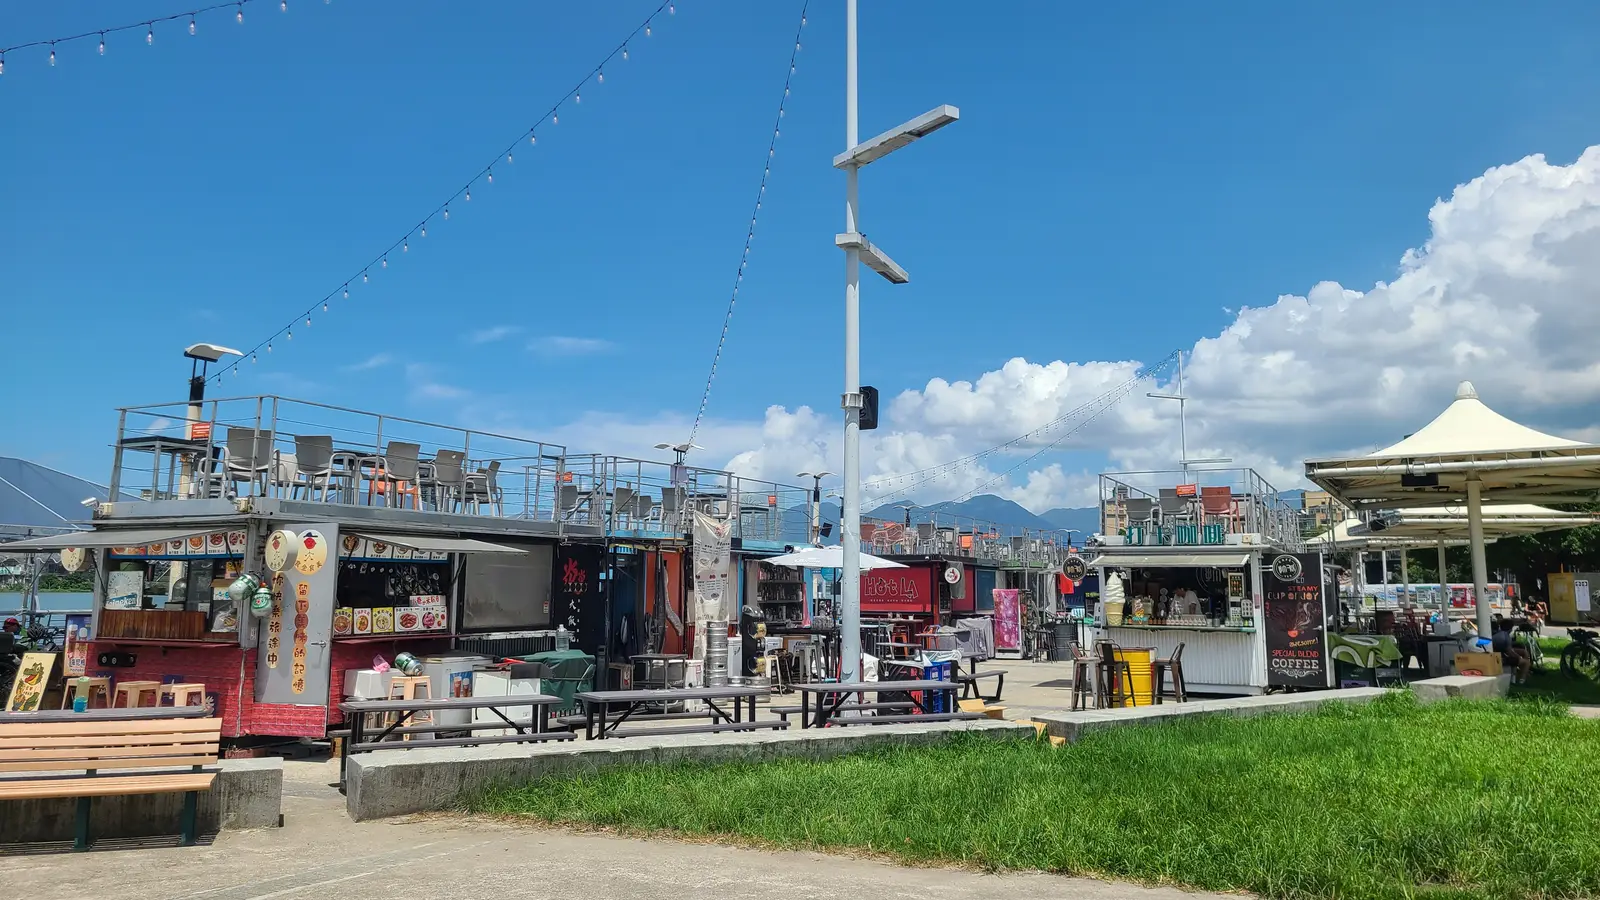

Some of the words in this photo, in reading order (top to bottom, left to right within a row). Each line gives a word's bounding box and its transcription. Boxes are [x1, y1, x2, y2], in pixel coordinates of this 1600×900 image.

[1272, 649, 1297, 657] SPECIAL
[1297, 650, 1319, 658] BLEND
[1271, 658, 1319, 669] COFFEE
